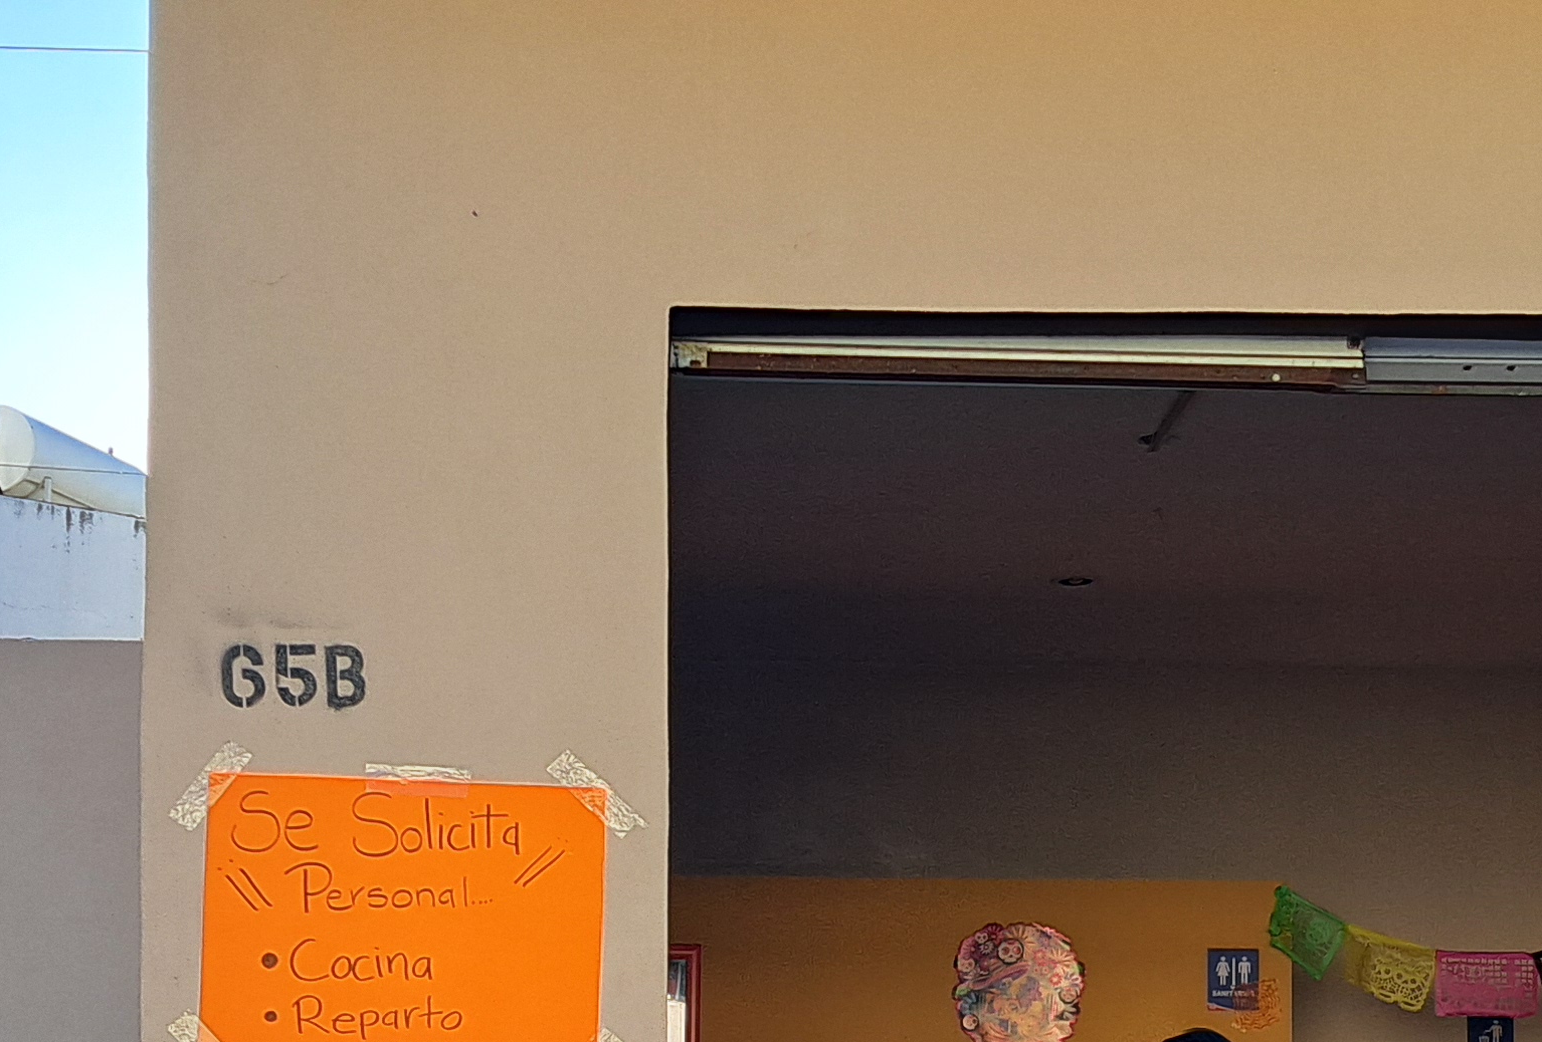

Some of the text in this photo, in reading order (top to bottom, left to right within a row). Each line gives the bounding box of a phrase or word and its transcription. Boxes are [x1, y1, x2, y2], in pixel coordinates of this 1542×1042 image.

[231, 790, 521, 857] Se Solicita
[289, 938, 433, 982] Cocina
[293, 994, 462, 1040] Reparto
